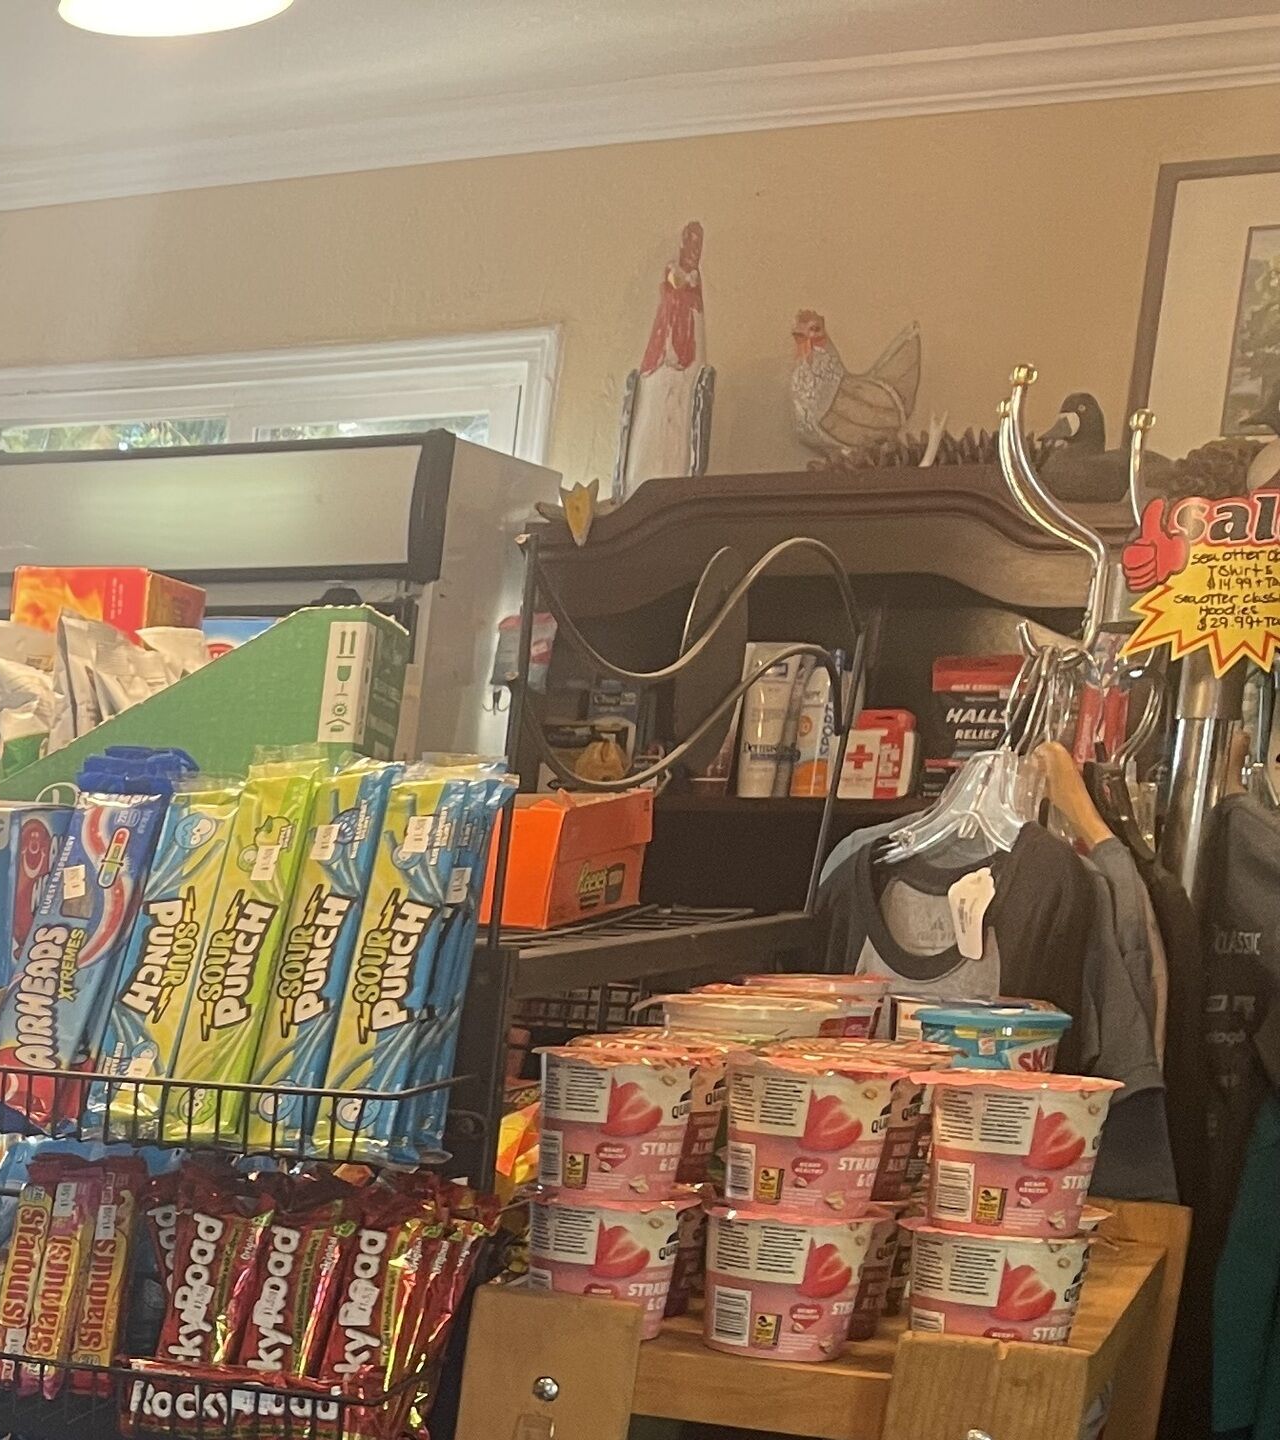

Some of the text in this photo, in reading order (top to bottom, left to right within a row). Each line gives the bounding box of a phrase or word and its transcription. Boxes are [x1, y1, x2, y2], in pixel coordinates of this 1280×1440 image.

[945, 707, 1012, 725] HALLS
[955, 728, 1000, 741] RELIEF
[57, 927, 88, 1001] XTREMES
[123, 899, 183, 1015] PUNCH
[162, 920, 199, 987] SOUR
[198, 928, 235, 1002] SOUR
[213, 900, 274, 1030] PUNCH
[278, 923, 315, 998] SOUR
[293, 895, 352, 1025] PUNCH
[354, 929, 393, 1003] SOUR
[371, 900, 433, 1032] PUNCH
[14, 923, 69, 1071] AIRHEADS
